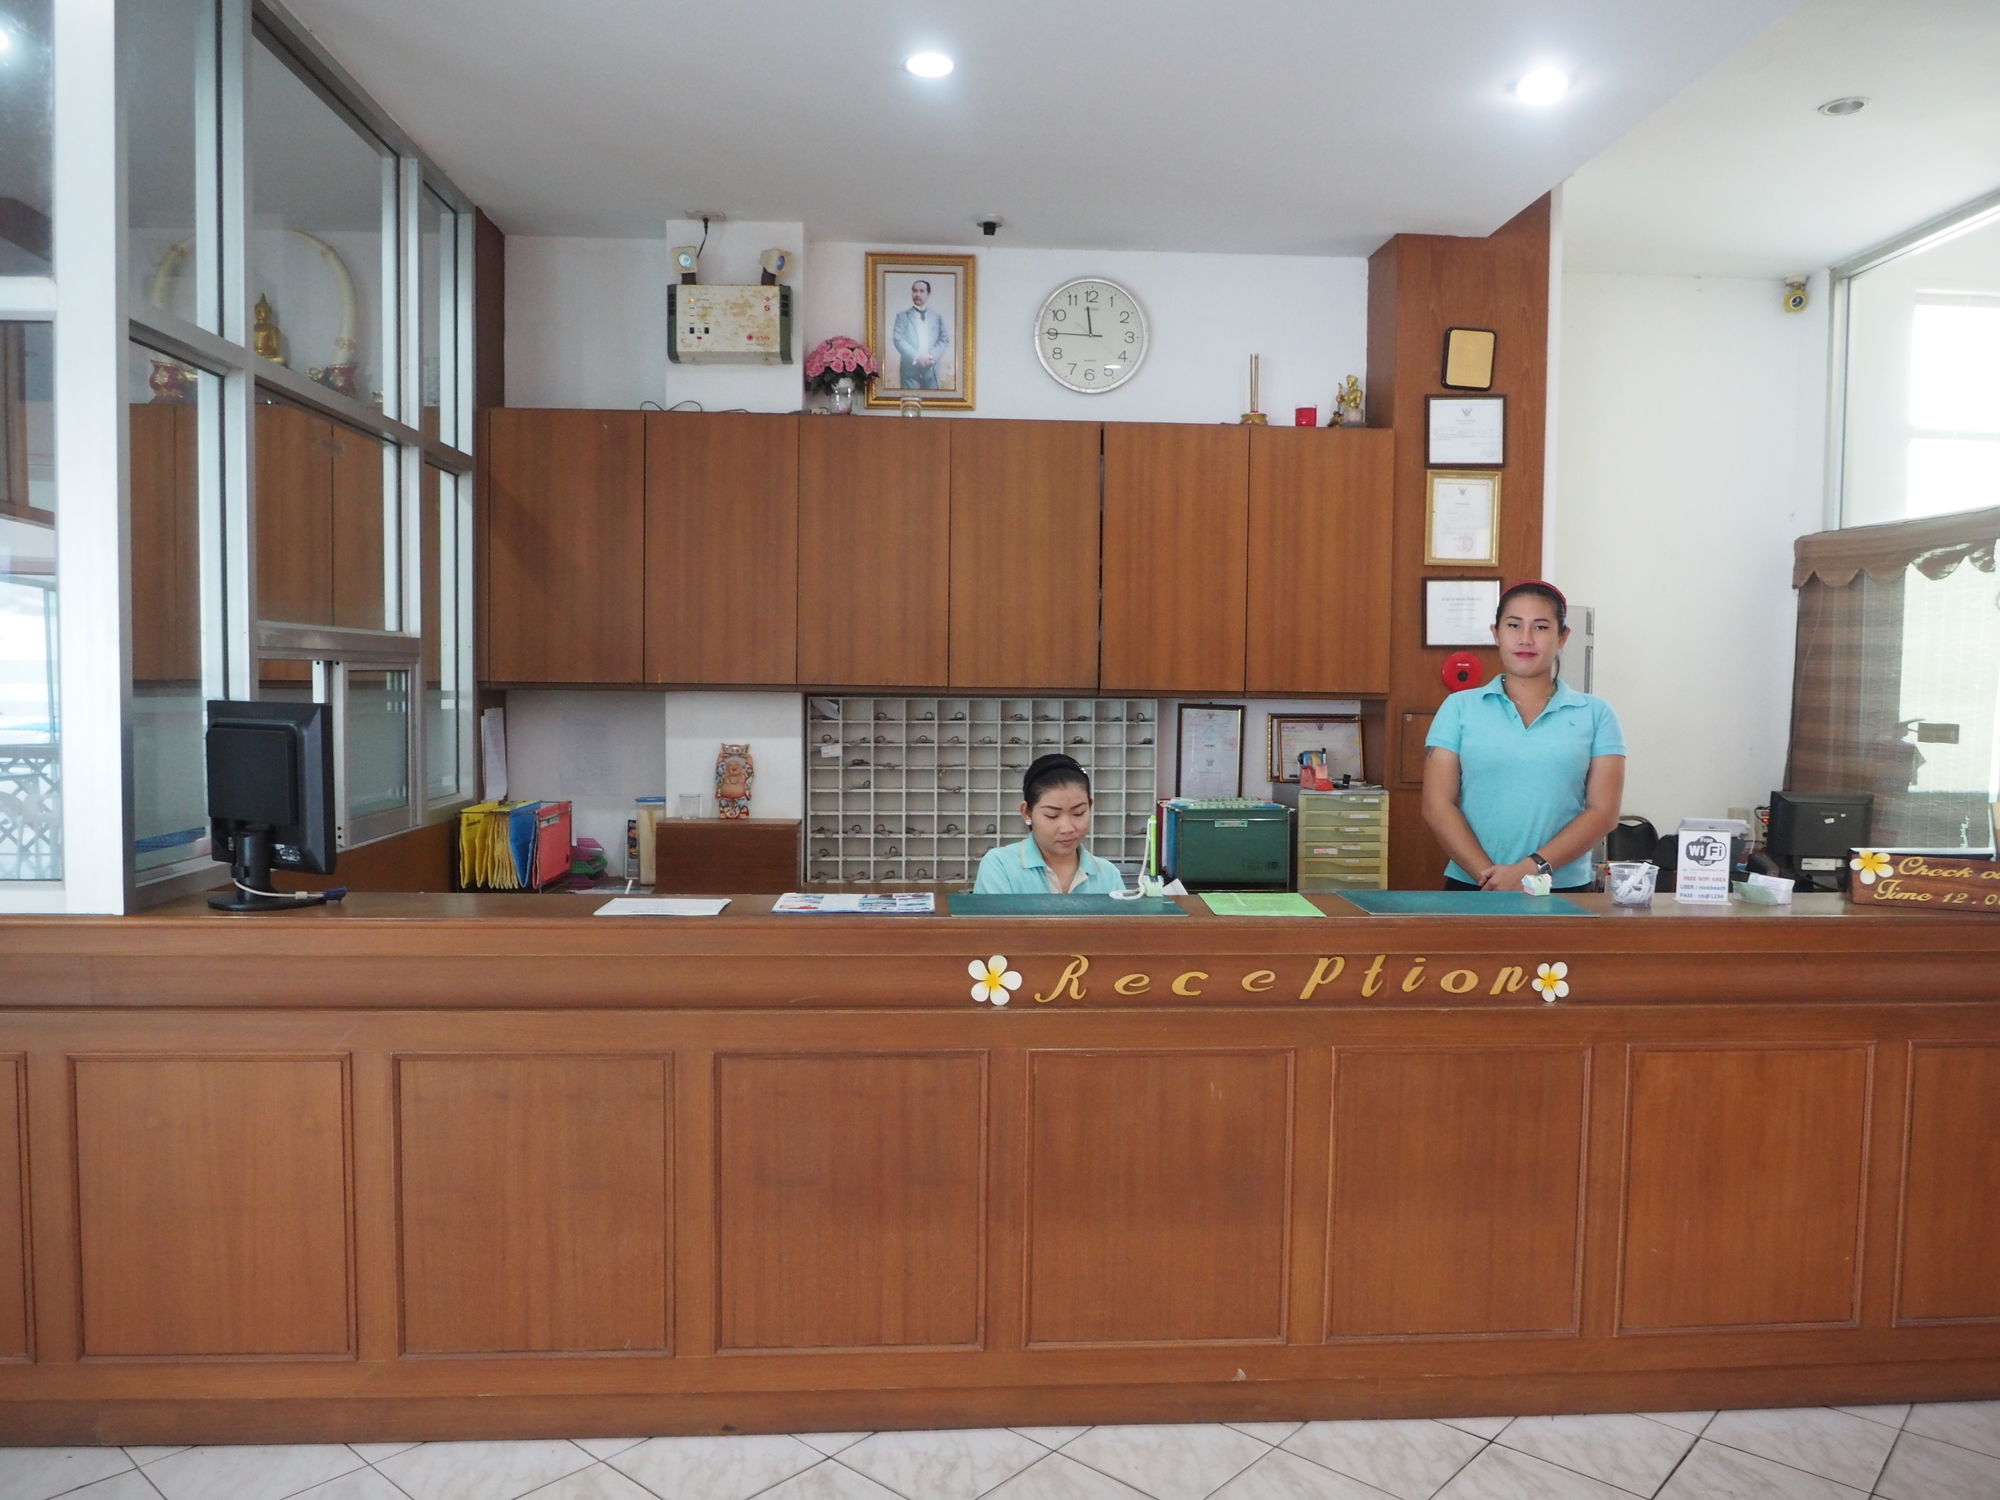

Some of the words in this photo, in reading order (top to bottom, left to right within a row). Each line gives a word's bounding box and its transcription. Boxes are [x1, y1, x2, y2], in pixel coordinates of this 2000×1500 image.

[1068, 294, 1078, 306] 11
[1085, 290, 1099, 303] 12
[1052, 309, 1067, 322] 10
[1119, 311, 1130, 324] 2
[1047, 327, 1058, 341] 9
[1124, 331, 1135, 344] 3
[1051, 347, 1063, 360] 8
[1118, 350, 1128, 363] 4
[1067, 363, 1077, 375] 7
[1084, 368, 1095, 381] 6
[1103, 365, 1114, 377] 5
[1898, 856, 1973, 878] Check
[1873, 879, 1932, 902] Time
[1034, 954, 1528, 1002] Reception
